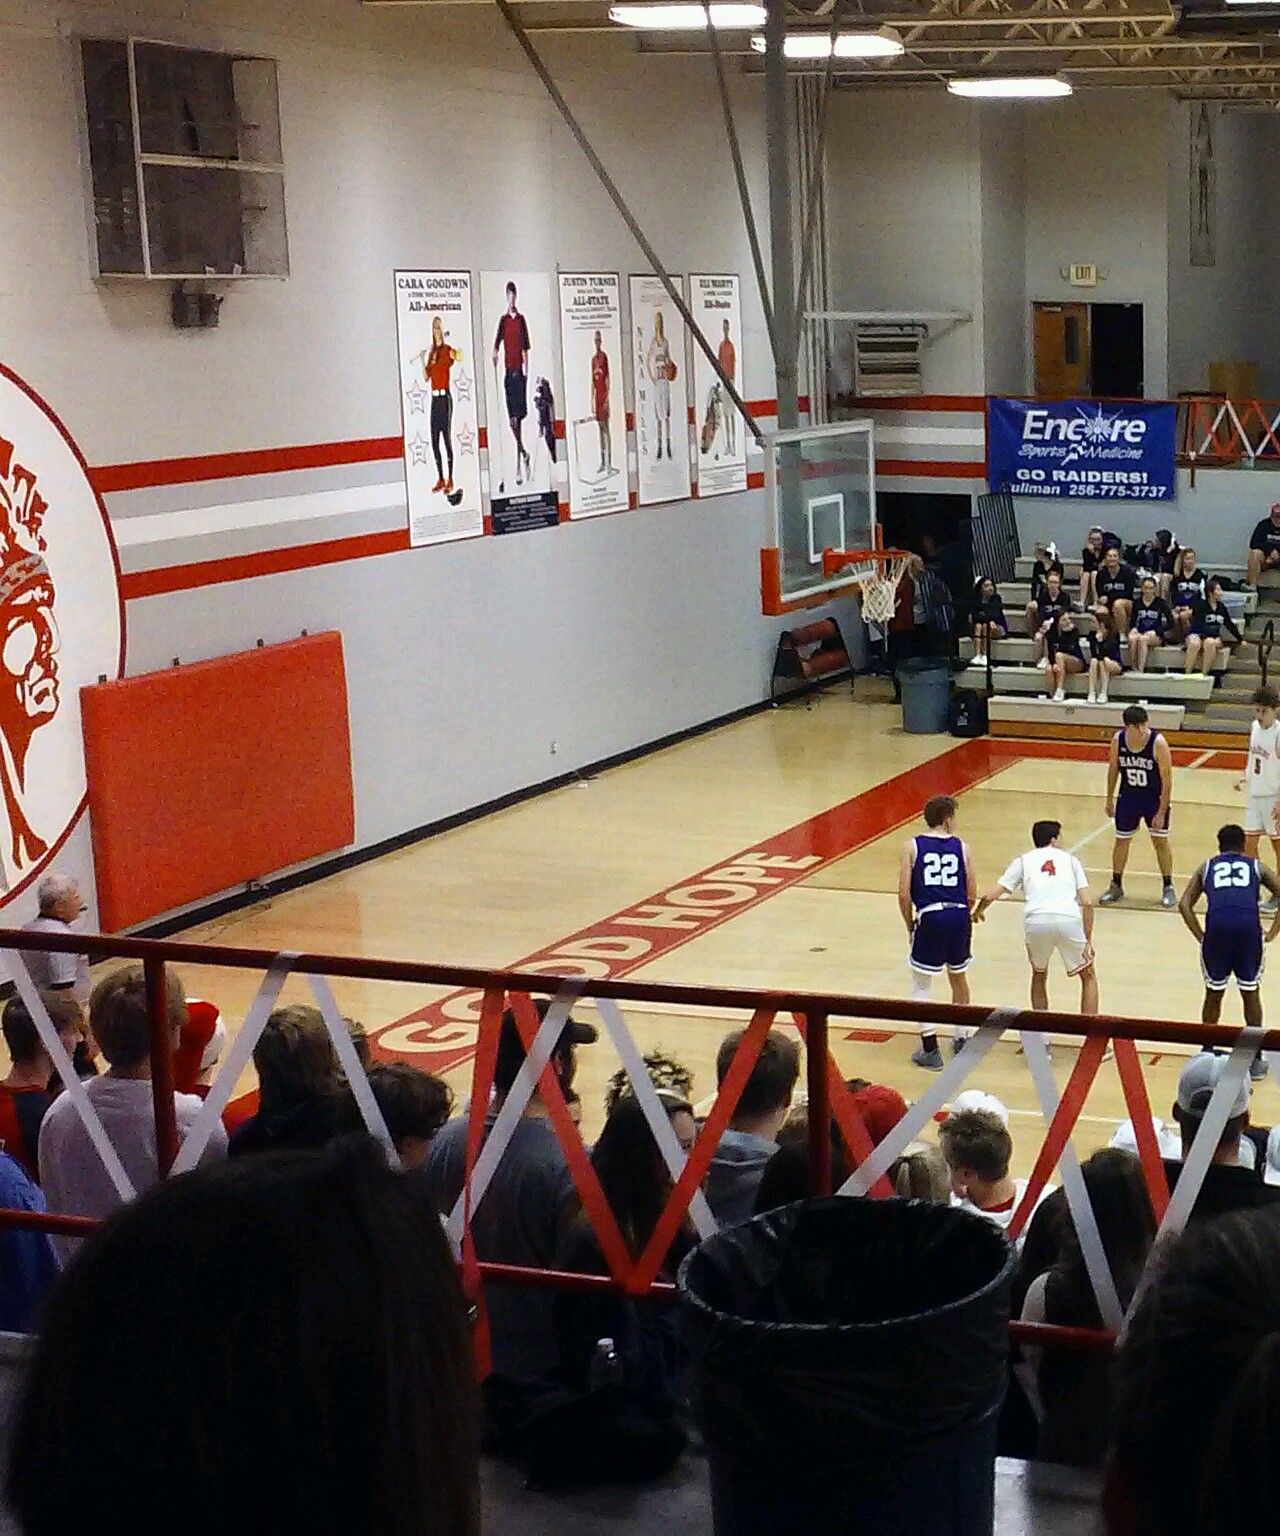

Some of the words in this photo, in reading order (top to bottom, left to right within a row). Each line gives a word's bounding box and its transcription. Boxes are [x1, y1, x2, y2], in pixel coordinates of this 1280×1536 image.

[398, 278, 424, 289] CARA
[426, 278, 469, 289] GOODWIN
[409, 301, 462, 312] All-American
[1017, 444, 1067, 460] Sports
[1084, 445, 1144, 460] Medicine
[1016, 469, 1046, 481] GO
[1052, 470, 1149, 484] RAIDERS!
[1010, 482, 1061, 495] ullman
[1068, 484, 1167, 498] 256-775-3737
[1119, 756, 1154, 770] HAWKS
[1127, 769, 1148, 787] 50
[923, 853, 959, 887] 22
[1040, 859, 1057, 876] 4
[1213, 861, 1250, 888] 23
[610, 851, 825, 930] HOPE
